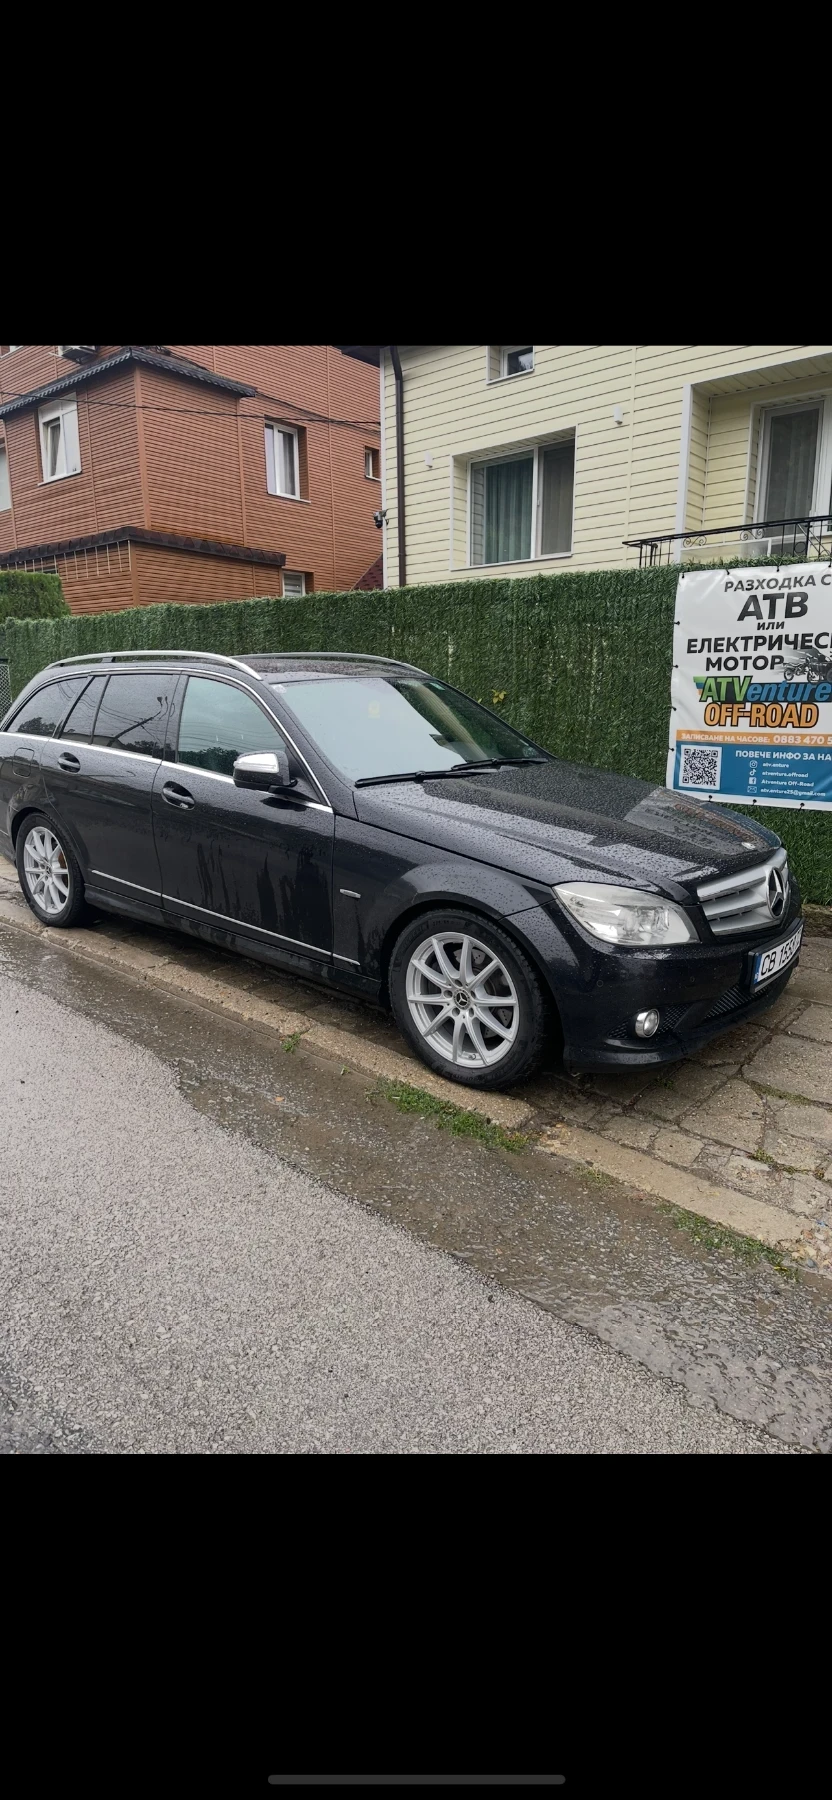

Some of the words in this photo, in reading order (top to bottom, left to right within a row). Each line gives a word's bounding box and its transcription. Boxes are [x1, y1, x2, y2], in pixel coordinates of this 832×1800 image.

[724, 575, 817, 592] РАЗХОДКА
[737, 591, 809, 621] АТВ
[705, 655, 784, 671] МОТОР
[699, 675, 832, 703] ATVenture
[704, 702, 819, 728] OFF-ROAD
[681, 733, 724, 742] ЗАПИСВАНЕ
[773, 735, 801, 745] 0883
[803, 735, 825, 745] 470
[735, 750, 771, 759] ПОВЕЧЕ
[772, 751, 801, 761] ИНФО
[802, 753, 816, 761] ЗА
